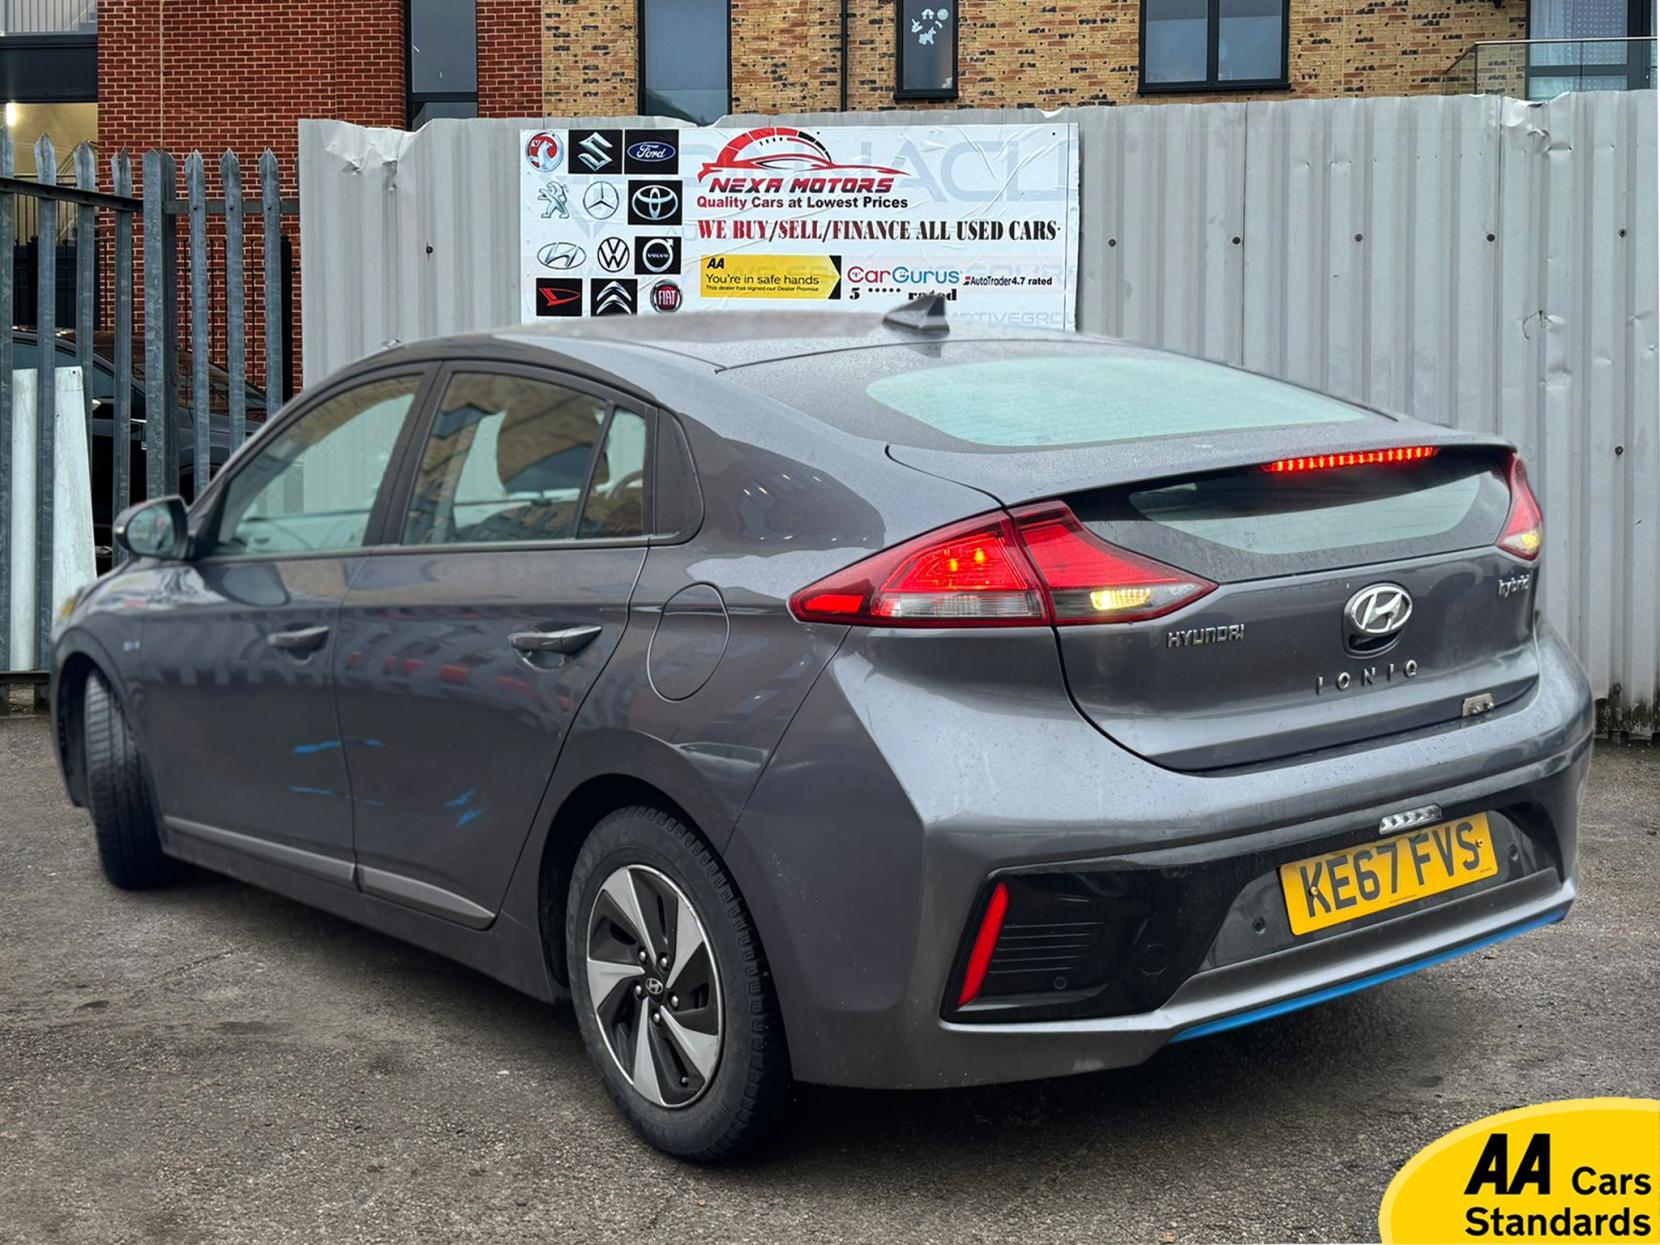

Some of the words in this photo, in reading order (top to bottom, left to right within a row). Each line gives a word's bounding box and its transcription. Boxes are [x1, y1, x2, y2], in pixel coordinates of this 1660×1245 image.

[636, 144, 666, 159] Ford
[709, 178, 784, 193] NEXA
[789, 178, 894, 193] MOTORS
[697, 196, 747, 210] Quality
[752, 196, 784, 208] Cars
[788, 197, 802, 208] at
[807, 196, 858, 208] Lowest
[863, 196, 908, 208] Prices
[698, 220, 727, 240] WE
[916, 220, 950, 240] ALL
[956, 220, 1004, 240] USED
[1009, 220, 1057, 240] CARS
[707, 257, 725, 269] AA
[706, 274, 741, 284] You're
[744, 274, 754, 284] in
[757, 274, 781, 285] safe
[784, 275, 819, 285] hands
[847, 266, 960, 284] CarGurus
[971, 276, 1011, 286] AutoTrader
[1011, 277, 1026, 286] 4.7
[1028, 277, 1052, 286] rated
[658, 290, 676, 306] FIAT
[849, 287, 860, 300] 5
[1167, 624, 1245, 648] HYUNDAI
[1315, 659, 1418, 695] IONIQ
[1300, 841, 1398, 918] KE67
[1408, 821, 1481, 887] FVS
